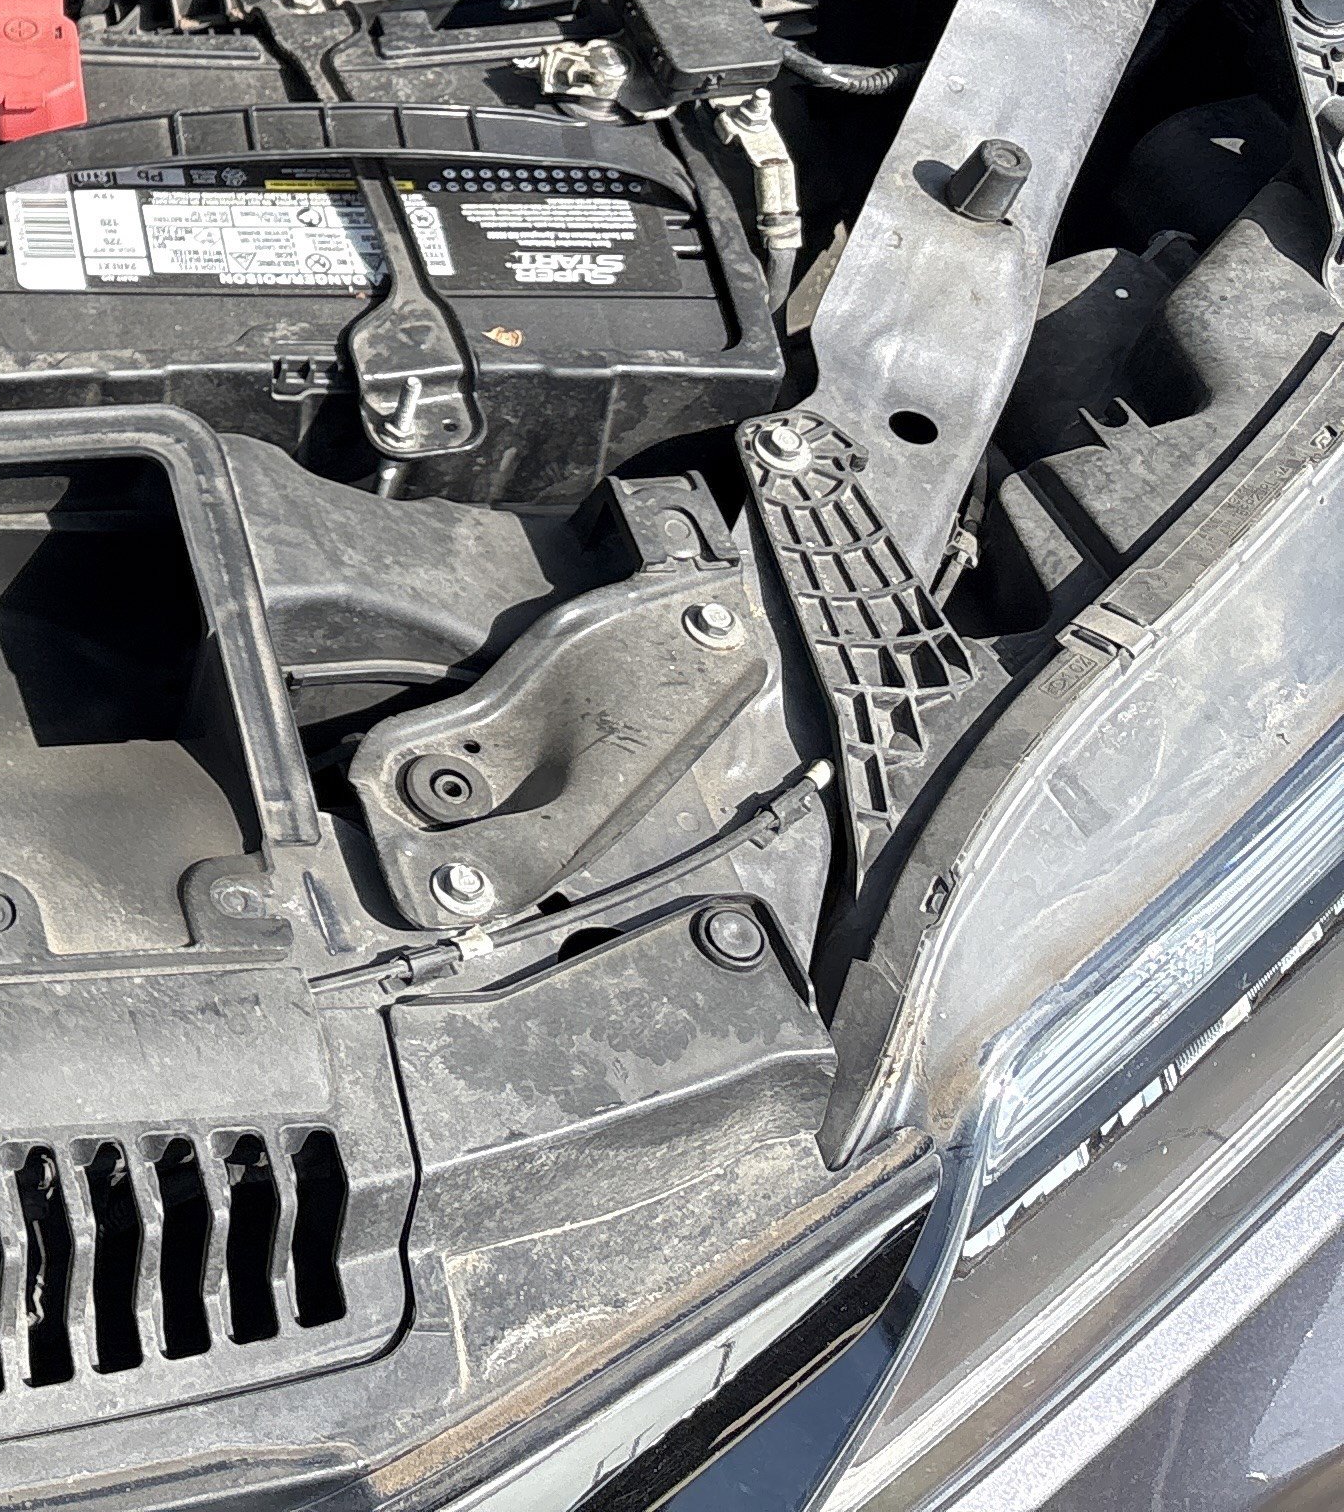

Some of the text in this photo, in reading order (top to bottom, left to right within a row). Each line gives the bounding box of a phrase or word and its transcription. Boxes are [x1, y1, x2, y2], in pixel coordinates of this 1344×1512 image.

[136, 170, 163, 183] Pb
[515, 254, 626, 273] START
[219, 272, 368, 286] DANGER/POISON
[514, 269, 616, 285] SUPER
